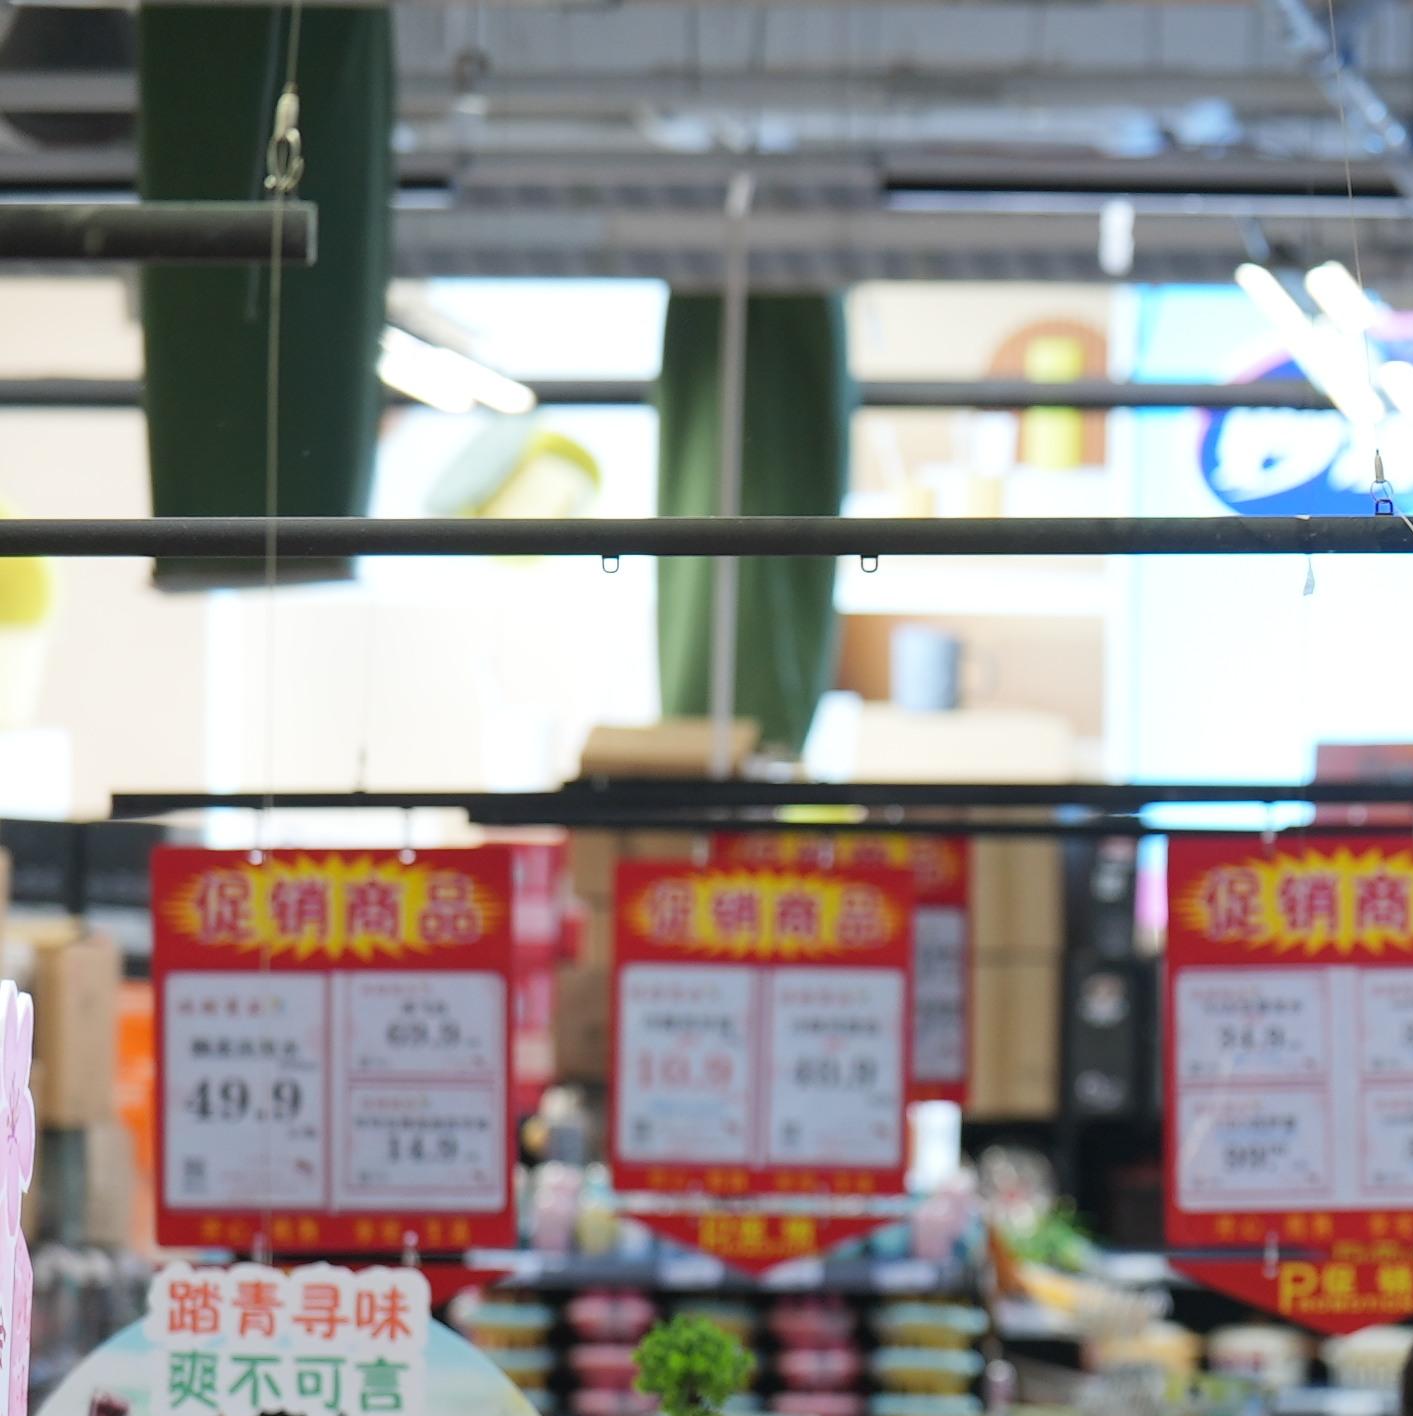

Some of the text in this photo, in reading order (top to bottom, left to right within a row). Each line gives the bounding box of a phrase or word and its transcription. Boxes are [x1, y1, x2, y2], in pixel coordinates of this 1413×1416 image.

[197, 869, 485, 945] 促销商品
[186, 1079, 303, 1122] 49.9
[168, 1281, 412, 1341] 踏青寻味
[169, 1350, 409, 1412] 爽不可言
